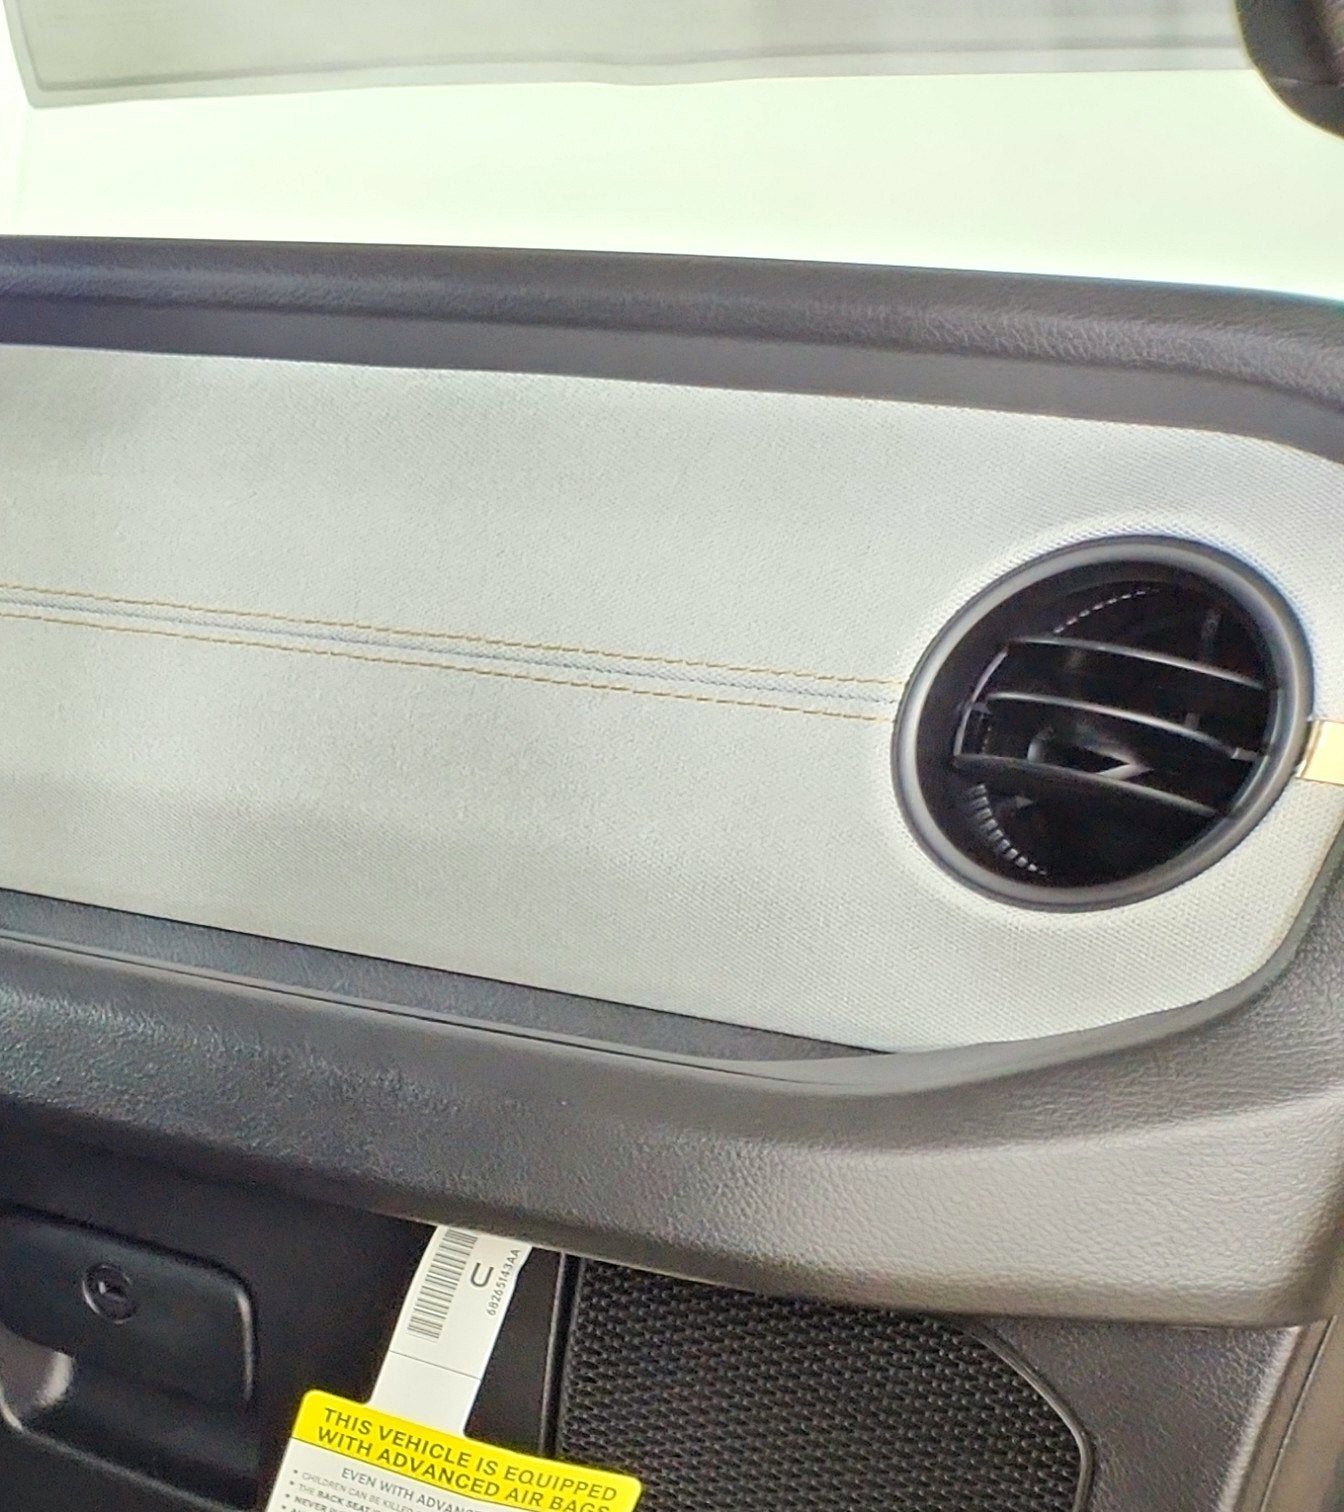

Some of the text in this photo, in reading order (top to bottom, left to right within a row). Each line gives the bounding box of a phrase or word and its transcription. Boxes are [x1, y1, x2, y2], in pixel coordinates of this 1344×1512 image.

[470, 1262, 495, 1288] U
[318, 1426, 373, 1457] WITH
[377, 1448, 500, 1497] ADVANCED
[504, 1488, 544, 1507] AIR
[325, 1408, 617, 1502] THIS VEHICLE IS EQUIPPED
[299, 1483, 315, 1496] THE
[317, 1490, 344, 1505] BACK
[302, 1472, 347, 1492] CHILDREN
[348, 1488, 367, 1500] CAN
[369, 1494, 380, 1505] BE
[341, 1467, 377, 1487] EVEN
[380, 1481, 414, 1501] WITH
[294, 1496, 328, 1512] NEVER
